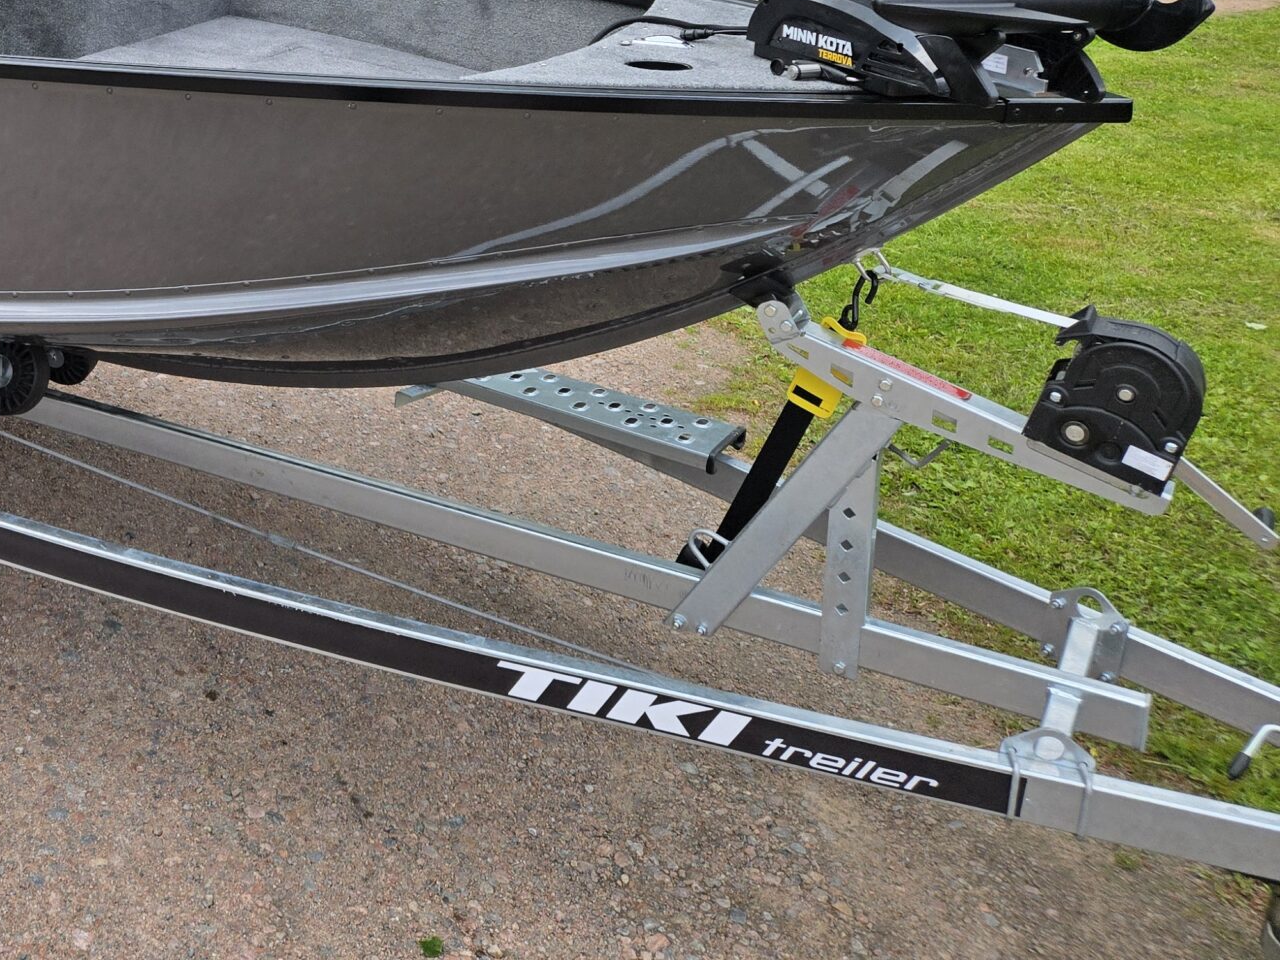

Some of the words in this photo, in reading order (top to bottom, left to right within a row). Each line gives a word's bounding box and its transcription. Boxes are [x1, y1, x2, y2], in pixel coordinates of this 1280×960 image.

[782, 24, 817, 46] MINN
[817, 33, 853, 57] KOTA
[818, 48, 853, 67] TERROVA
[497, 660, 752, 746] TIKI
[764, 738, 939, 791] treiler
